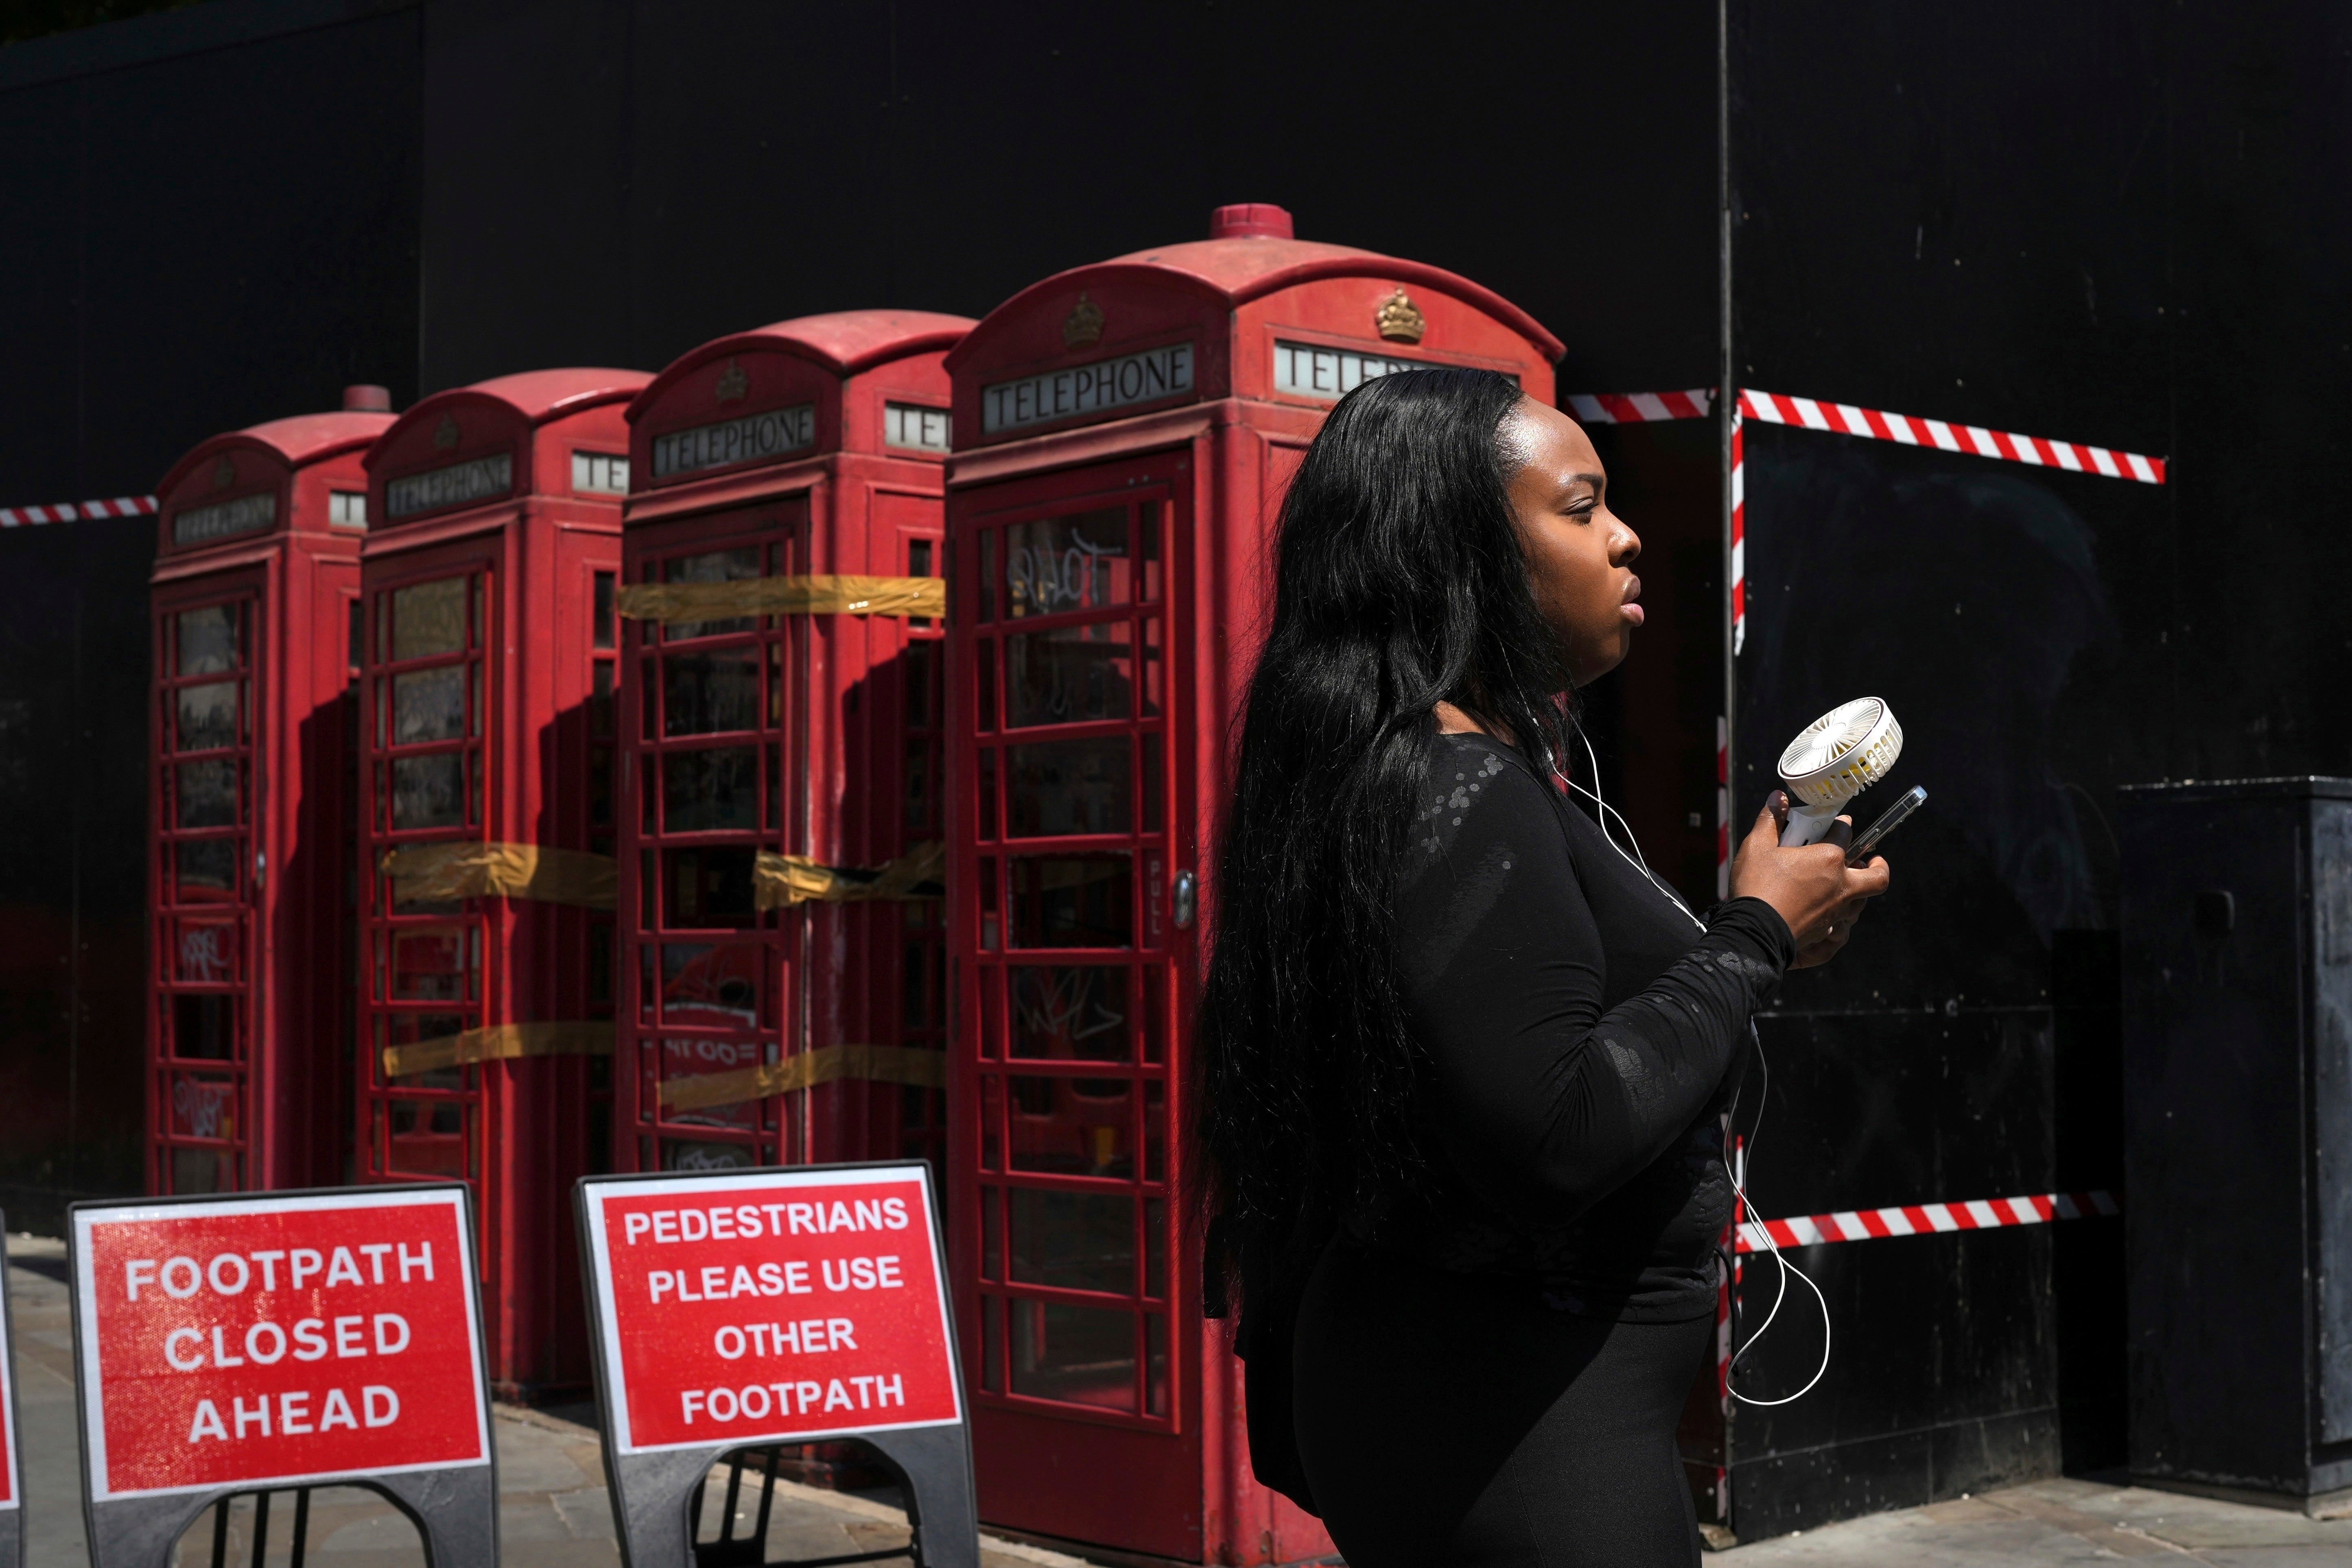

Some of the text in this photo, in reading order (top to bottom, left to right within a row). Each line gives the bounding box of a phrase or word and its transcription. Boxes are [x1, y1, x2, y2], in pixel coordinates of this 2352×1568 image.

[992, 348, 1187, 426] TELEPHONE
[660, 408, 811, 471] TELEPHONE
[1150, 860, 1161, 934] PULL
[624, 1197, 909, 1245] PEDESTRIANS
[125, 1241, 434, 1302] FOOTPATH
[648, 1255, 904, 1304] PLEASE USE
[164, 1313, 411, 1371] CLOSED
[714, 1318, 858, 1360] OTHER
[188, 1385, 400, 1443] AHEAD
[681, 1373, 905, 1424] FOOTPATH
